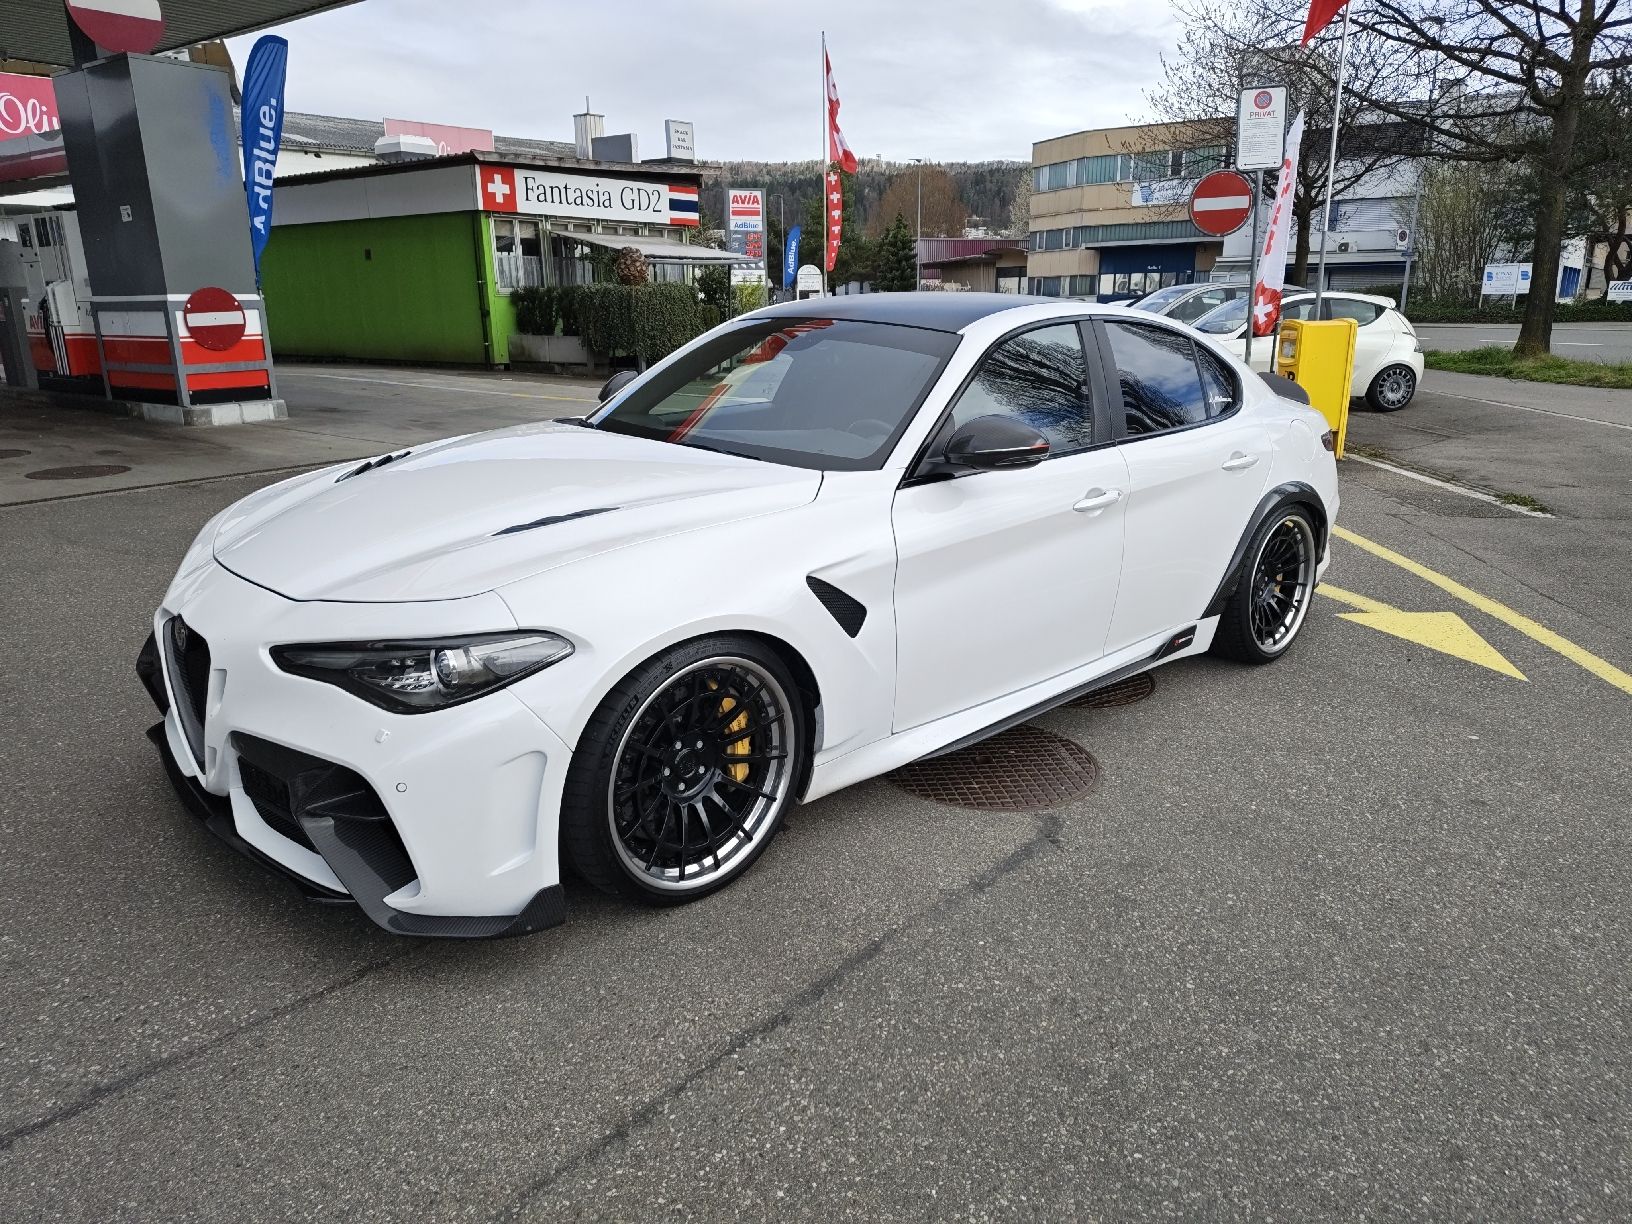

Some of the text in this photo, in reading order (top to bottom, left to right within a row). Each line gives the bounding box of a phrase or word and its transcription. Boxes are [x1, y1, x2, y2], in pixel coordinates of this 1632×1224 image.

[1249, 110, 1276, 119] PRIVAT
[523, 176, 662, 213] Fantasia GD2
[731, 192, 760, 205] AVIA
[734, 221, 760, 230] AdBlue
